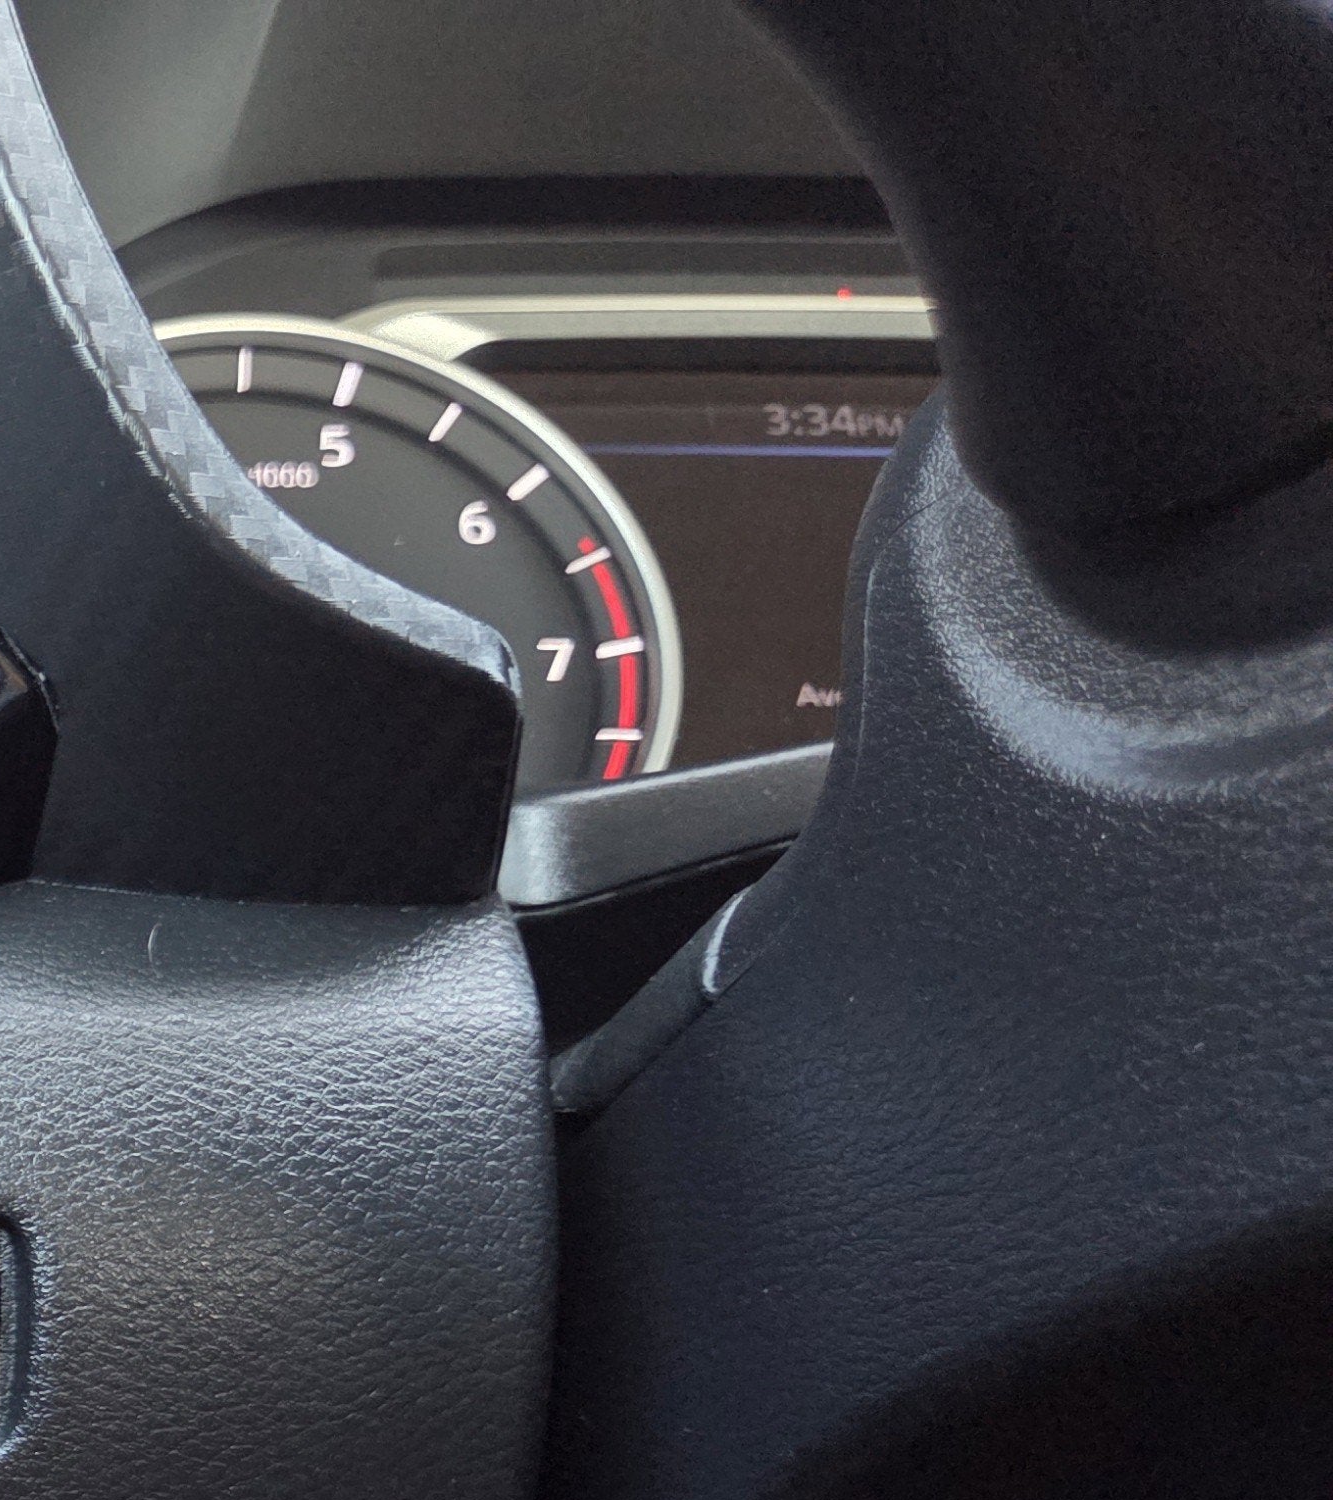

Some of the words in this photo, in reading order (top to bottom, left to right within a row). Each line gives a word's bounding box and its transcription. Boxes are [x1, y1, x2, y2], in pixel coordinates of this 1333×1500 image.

[318, 423, 355, 467] 5
[458, 500, 496, 545] 6
[536, 637, 576, 682] 7
